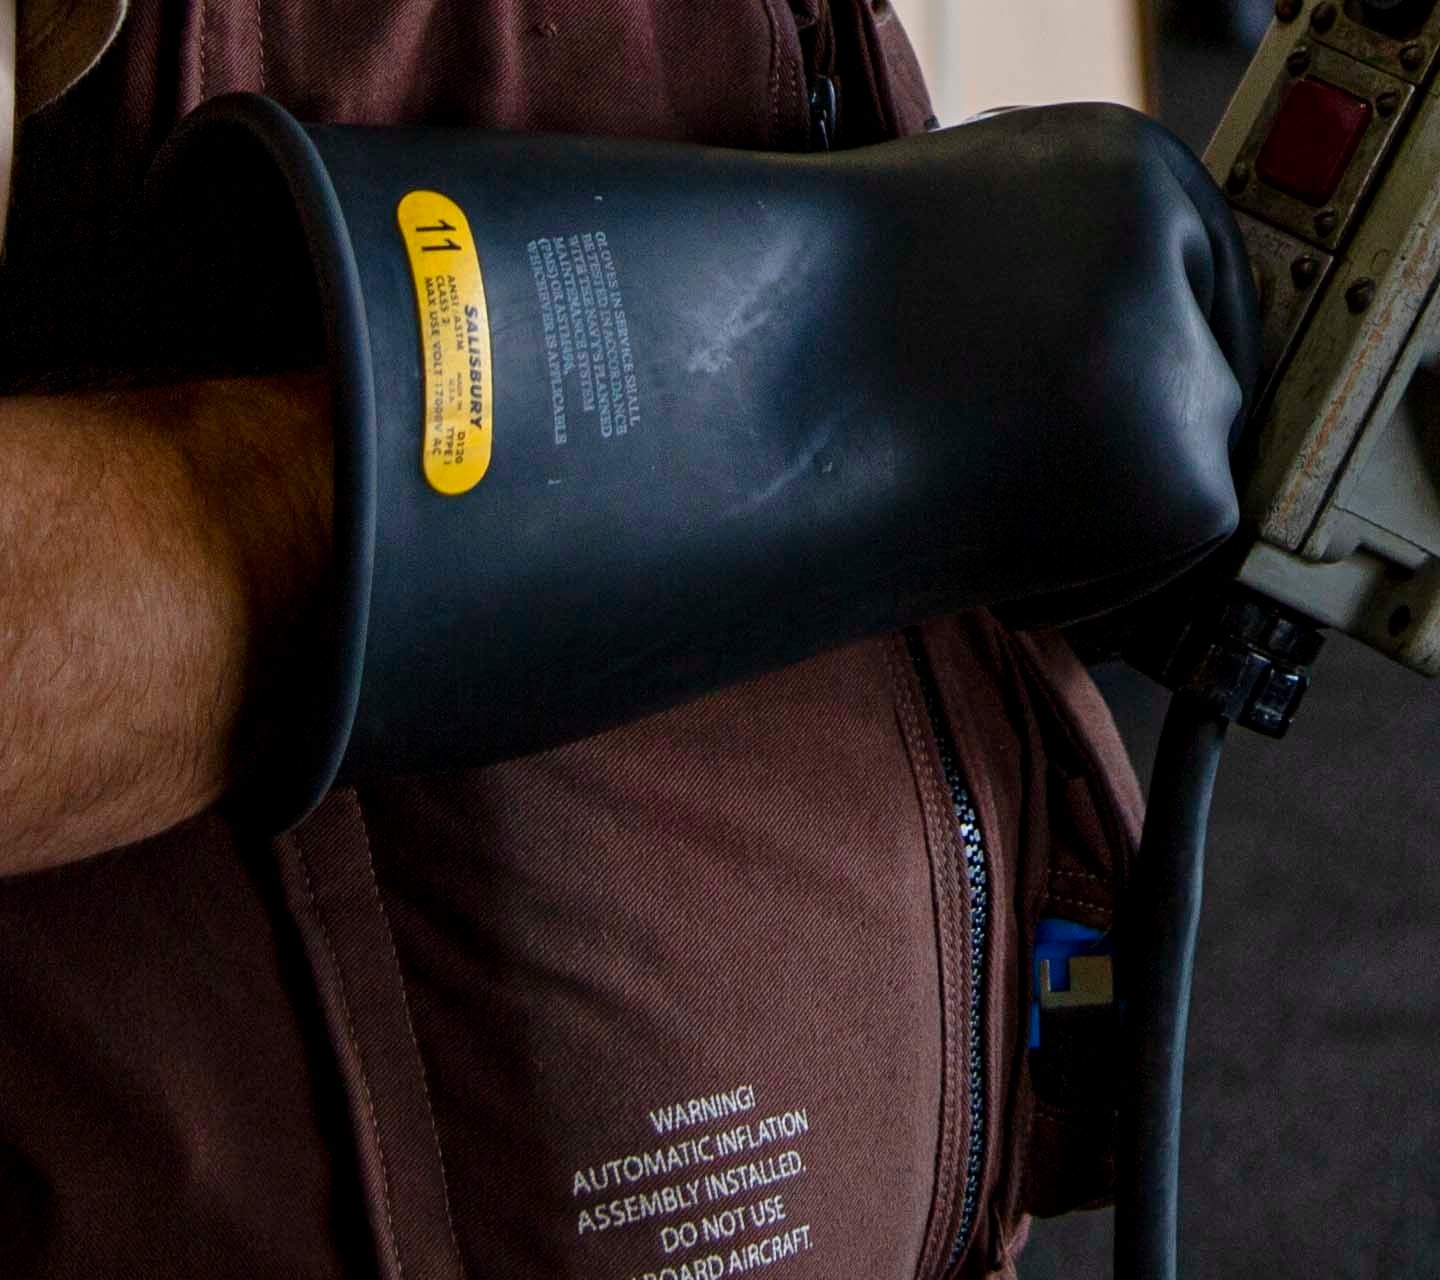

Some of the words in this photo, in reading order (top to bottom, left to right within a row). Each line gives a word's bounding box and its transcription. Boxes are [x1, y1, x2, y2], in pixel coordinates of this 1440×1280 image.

[415, 219, 462, 252] 11
[595, 231, 618, 288] GLOVES
[425, 277, 437, 306] MAX
[436, 275, 449, 312] CLASS
[447, 275, 459, 306] ANSI
[454, 316, 464, 351] ASTM
[610, 291, 622, 307] IN
[430, 312, 440, 336] USE
[527, 239, 555, 336] WHICHEVER
[547, 349, 567, 445] APPLICABLE
[553, 236, 587, 350] MAINTENANCE
[576, 351, 596, 412] SYSTEM
[568, 234, 588, 274] WITH
[593, 363, 613, 438] PLANNED
[588, 253, 608, 307] TESTED
[603, 327, 628, 436] ACCORDANCE
[615, 310, 635, 372] SERVICE
[433, 341, 443, 377] VOLT
[464, 304, 482, 430] SALISBURY
[625, 373, 641, 427] SHALL
[444, 426, 454, 457] TYPE
[455, 431, 466, 464] D120
[649, 1084, 756, 1134] WARNING!
[572, 1135, 714, 1197] AUTOMATIC
[716, 1107, 809, 1157] INFLATION
[577, 1179, 700, 1235] ASSEMBLY
[704, 1149, 807, 1201] INSTALLED.
[632, 1254, 724, 1280] OARD
[728, 1224, 814, 1275] AIRCRAFT.
[660, 1221, 698, 1254] DO
[702, 1207, 745, 1241] NOT
[750, 1195, 786, 1228] USE
